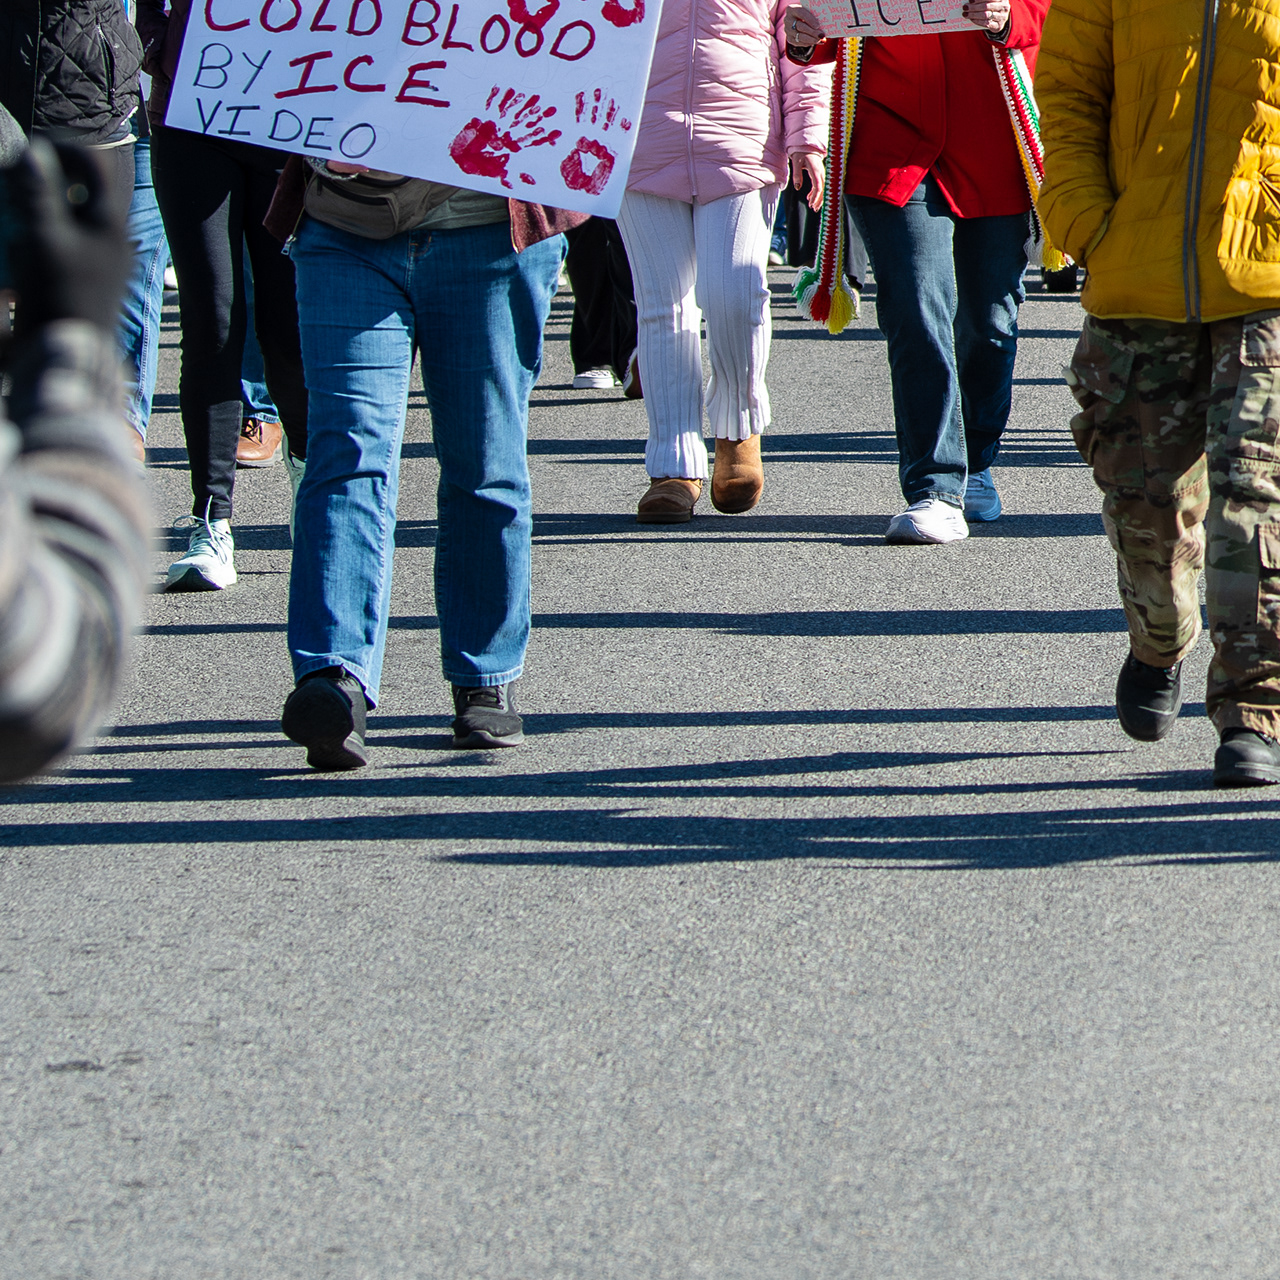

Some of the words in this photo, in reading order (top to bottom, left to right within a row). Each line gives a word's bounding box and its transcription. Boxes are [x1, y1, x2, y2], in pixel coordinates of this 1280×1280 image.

[193, 42, 272, 94] BY
[274, 50, 451, 109] ICE
[195, 97, 376, 158] VIDEO
